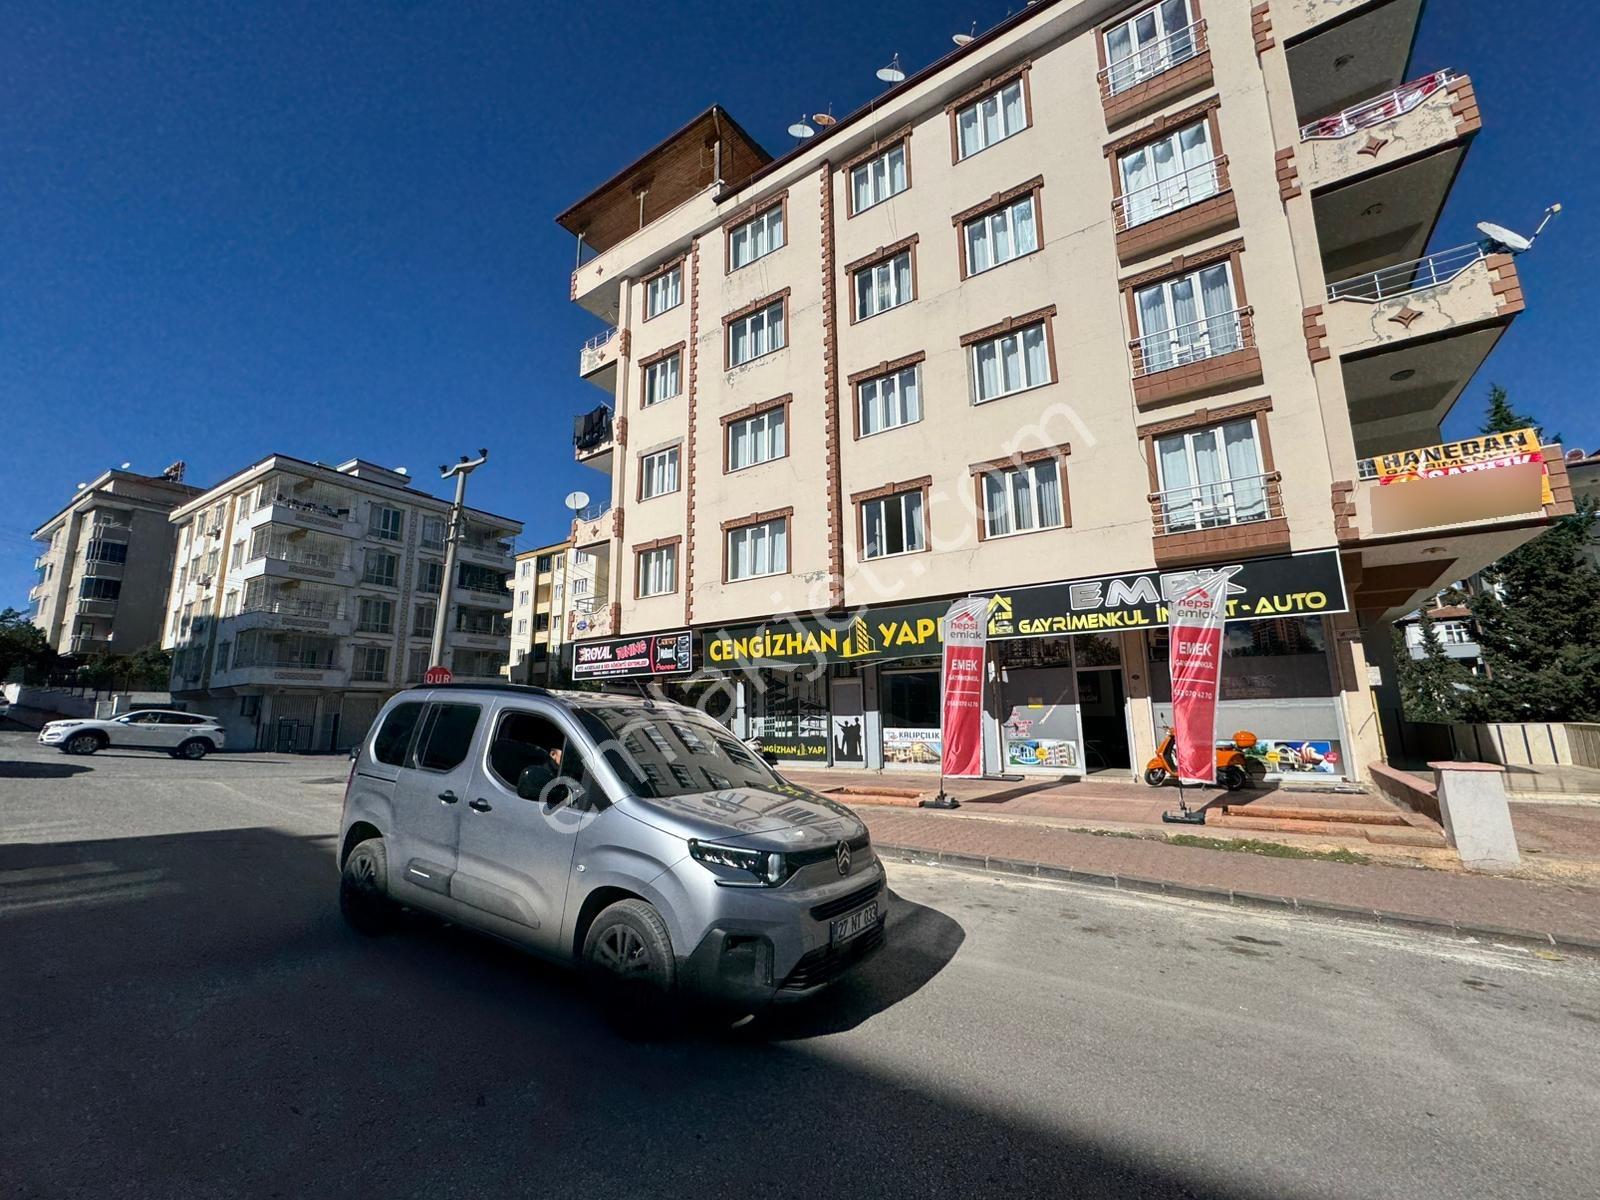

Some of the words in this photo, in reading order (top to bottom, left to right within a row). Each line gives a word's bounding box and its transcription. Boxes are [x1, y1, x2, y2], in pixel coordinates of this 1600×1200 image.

[1383, 432, 1527, 469] HANEDAN
[1178, 598, 1214, 611] hepsi
[1018, 612, 1149, 634] GAYRİMENKUL
[1254, 591, 1327, 614] AUTO
[1177, 608, 1218, 620] emlak
[950, 620, 978, 632] hepsi
[709, 628, 837, 661] CENGİZHAN
[878, 616, 944, 647] YAPI
[950, 631, 982, 640] emlak
[584, 646, 612, 661] ROYAL
[1179, 641, 1212, 656] EMEK
[951, 659, 978, 671] EMEK
[427, 673, 450, 684] DUR
[898, 731, 940, 740] KALIPÇILIK
[763, 744, 797, 754] NGİZHAN
[807, 745, 826, 755] YAPI
[837, 918, 848, 939] 27
[851, 911, 862, 932] NT
